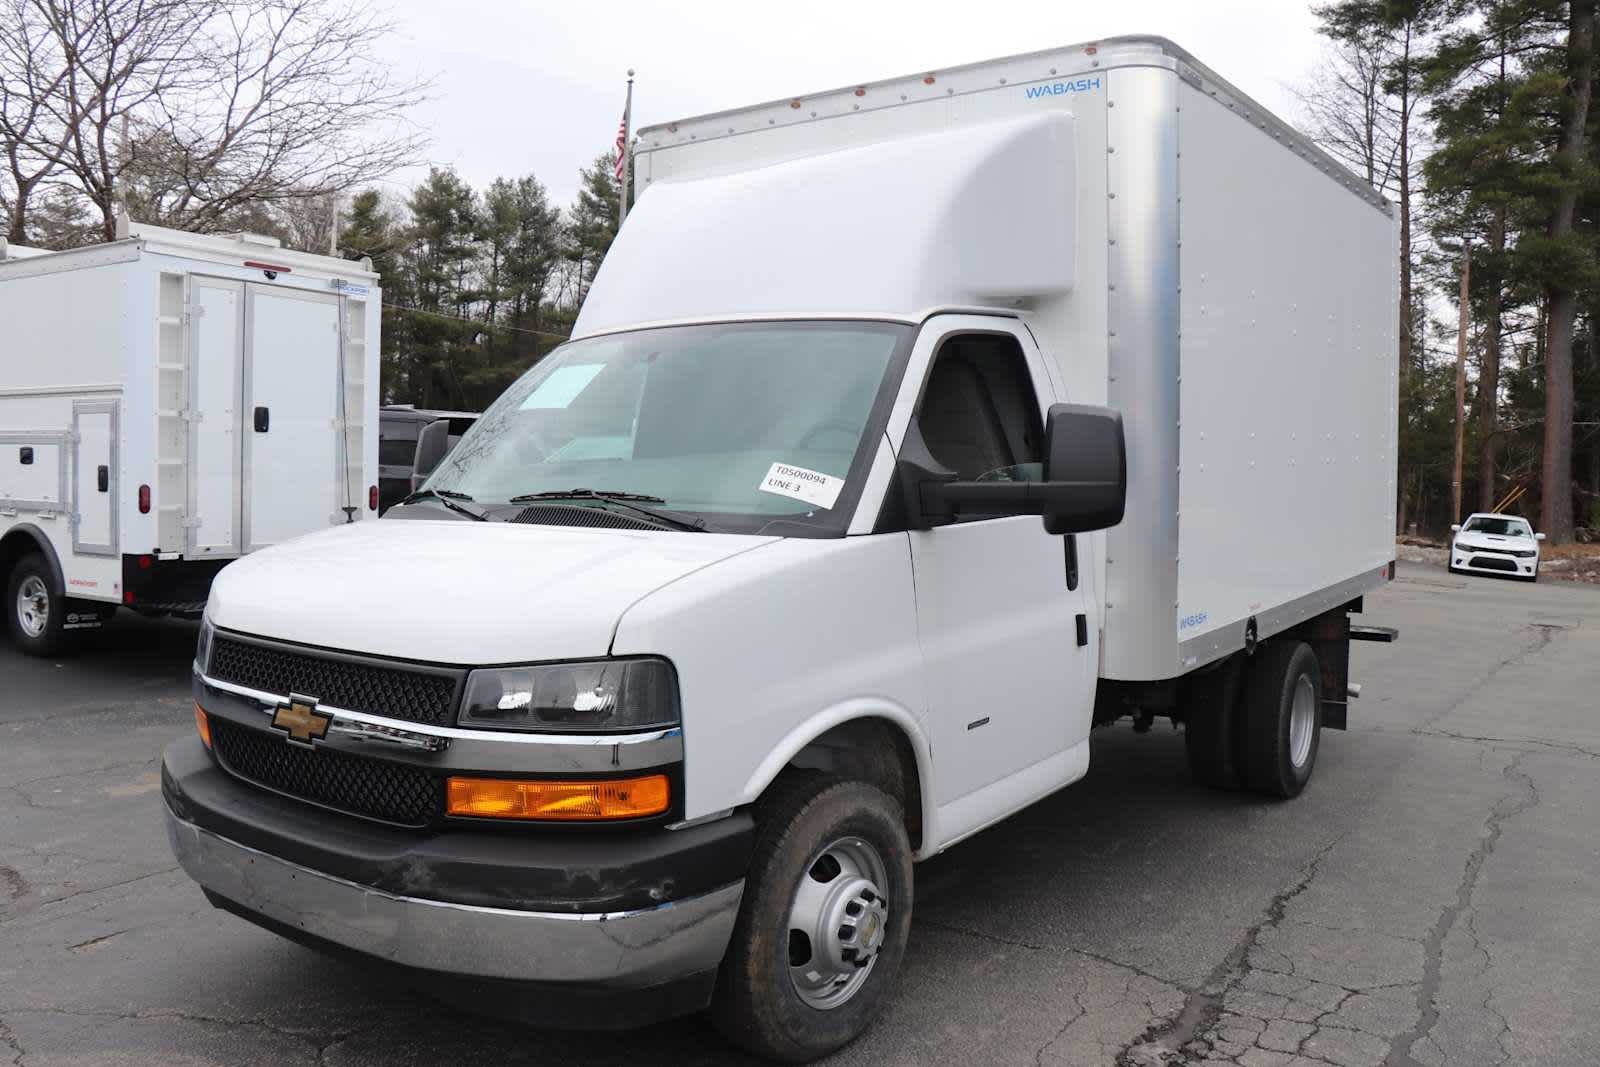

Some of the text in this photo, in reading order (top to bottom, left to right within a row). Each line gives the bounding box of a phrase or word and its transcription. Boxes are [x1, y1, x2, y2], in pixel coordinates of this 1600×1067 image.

[1026, 78, 1100, 98] WABASH
[768, 478, 801, 492] LINE 3
[776, 465, 826, 485] T0500094
